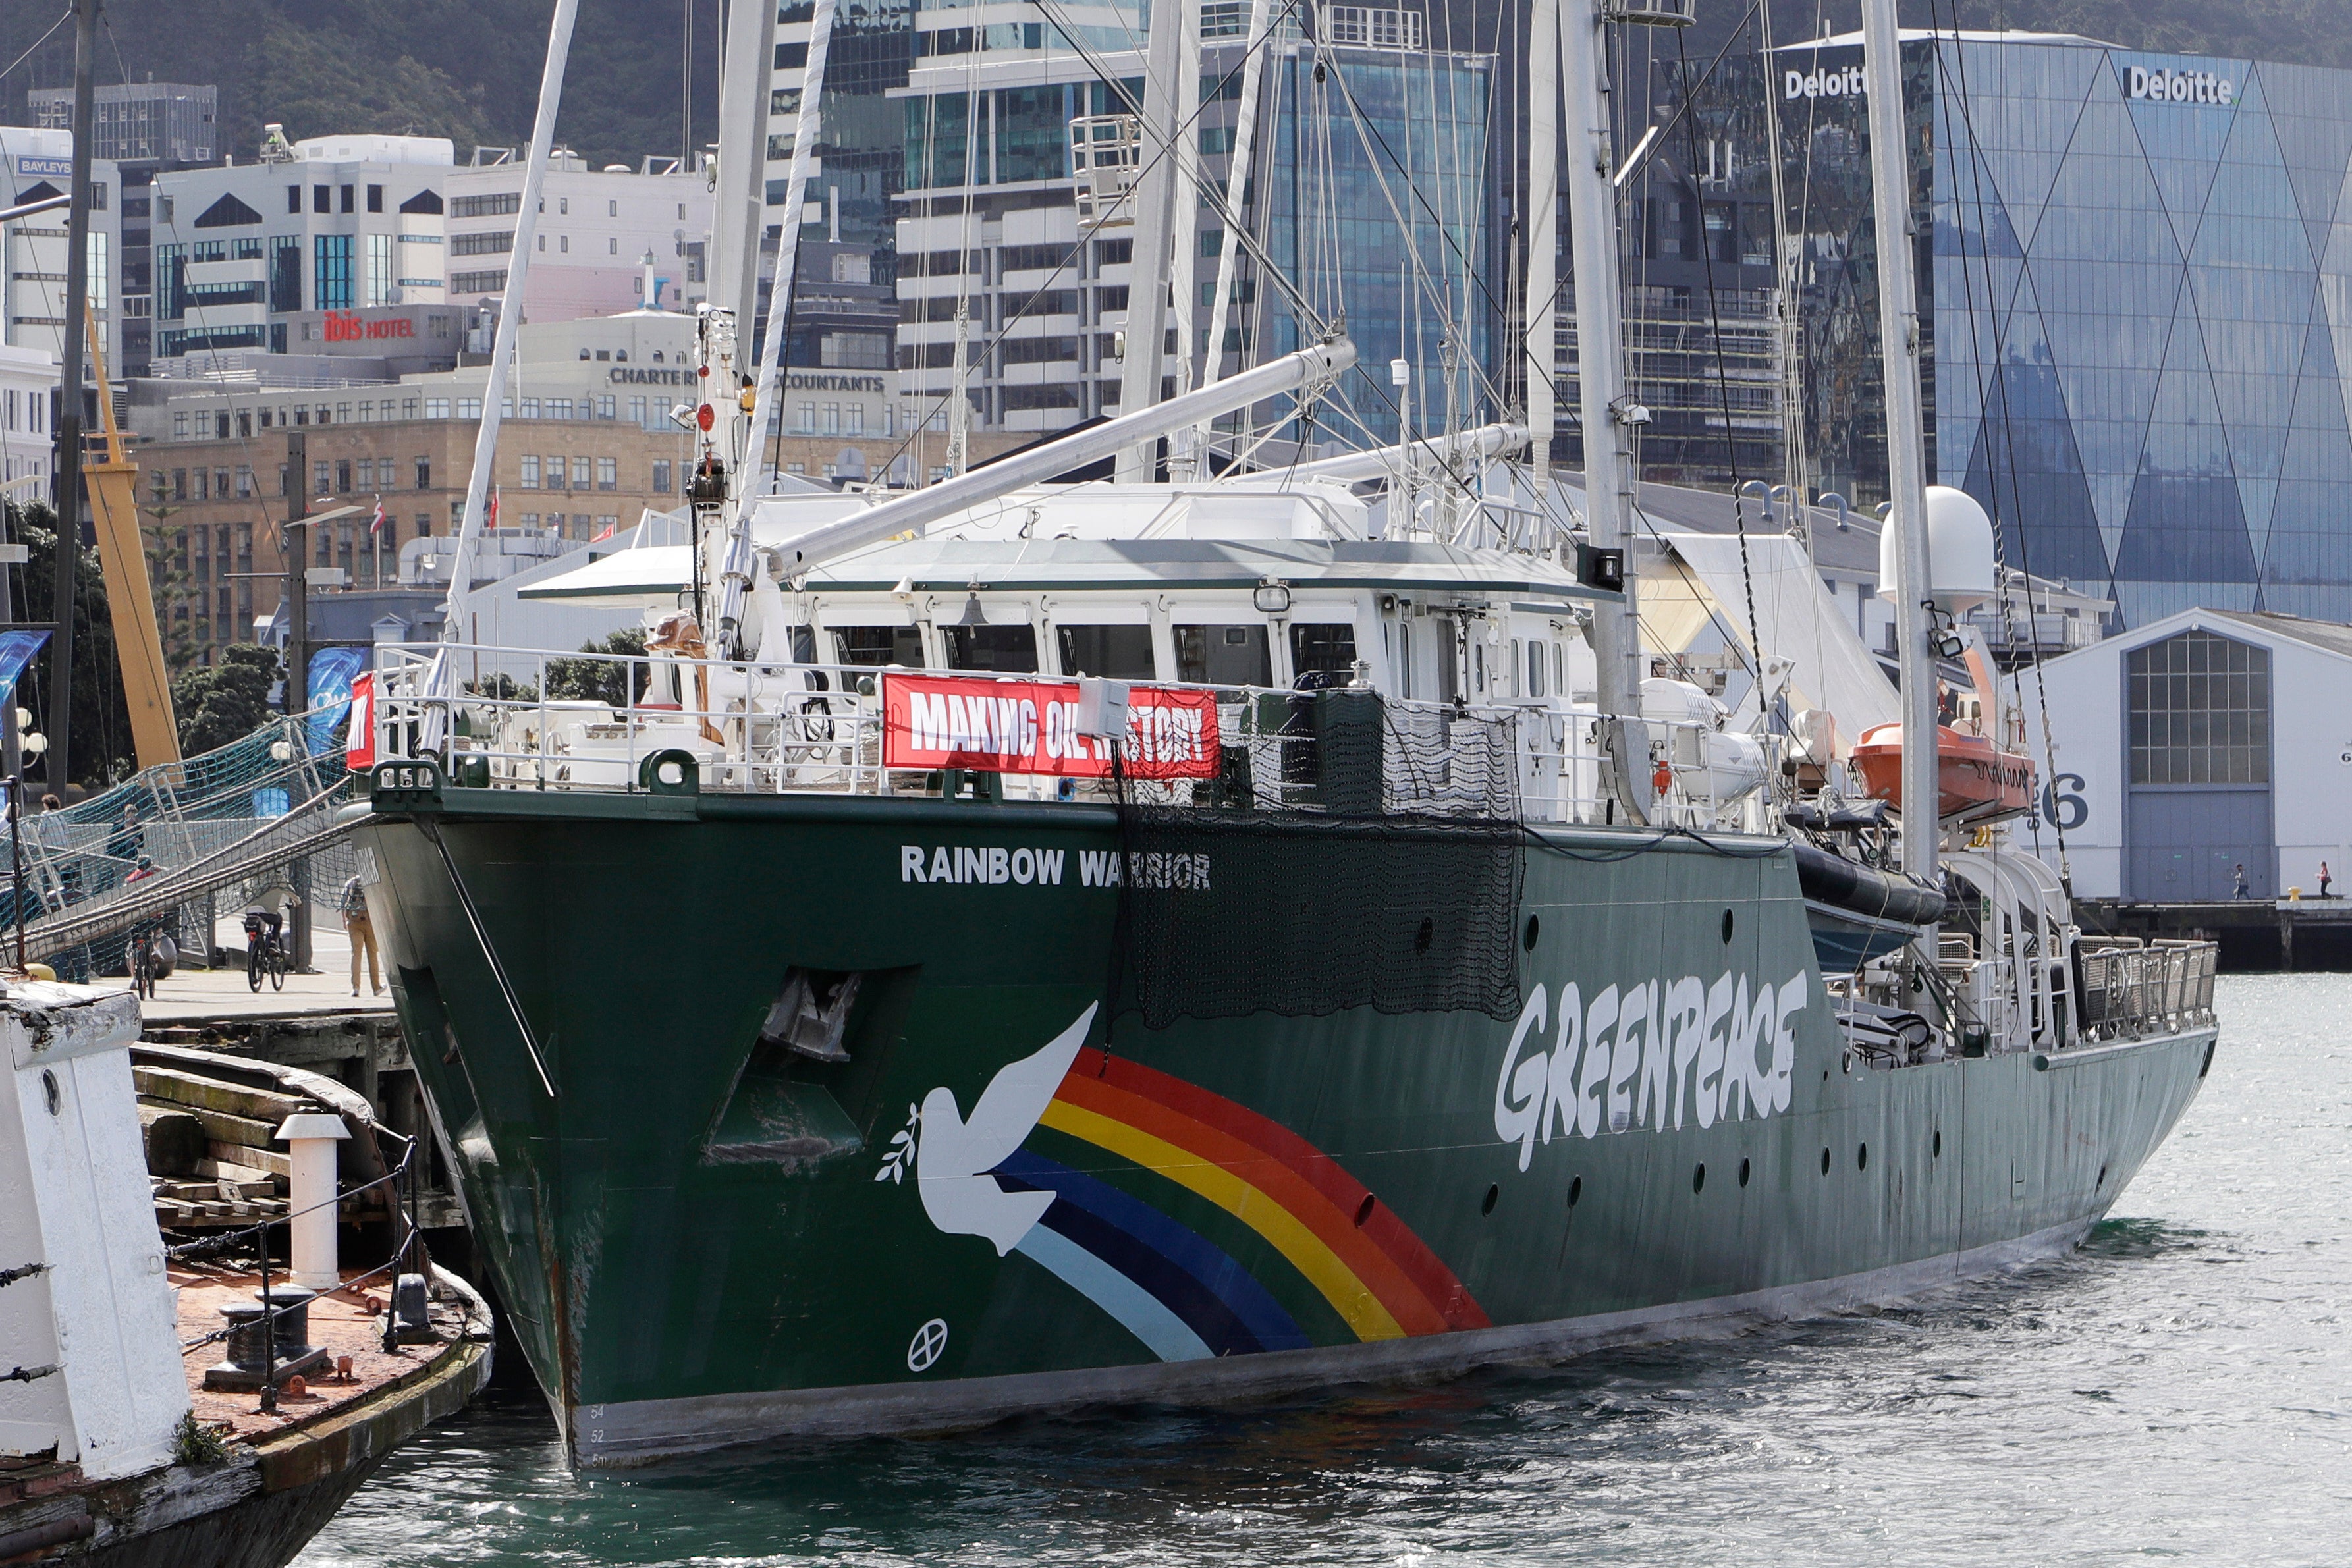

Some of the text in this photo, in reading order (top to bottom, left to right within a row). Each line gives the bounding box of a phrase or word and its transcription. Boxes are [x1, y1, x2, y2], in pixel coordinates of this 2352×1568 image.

[1786, 66, 1867, 99] Deloitt
[22, 161, 72, 173] BAYLEYS
[325, 310, 415, 341] ibis HOTEL
[610, 367, 885, 392] CHARTER COUNTANTS
[910, 691, 1203, 763] MAKING OIL STORY
[2341, 752, 2351, 762] 6
[2042, 773, 2088, 830] 6
[901, 845, 1211, 890] RAINBOW WARRIOR
[1494, 969, 1807, 1173] GREENPEACE
[591, 1405, 604, 1419] 54
[591, 1430, 604, 1443] 52
